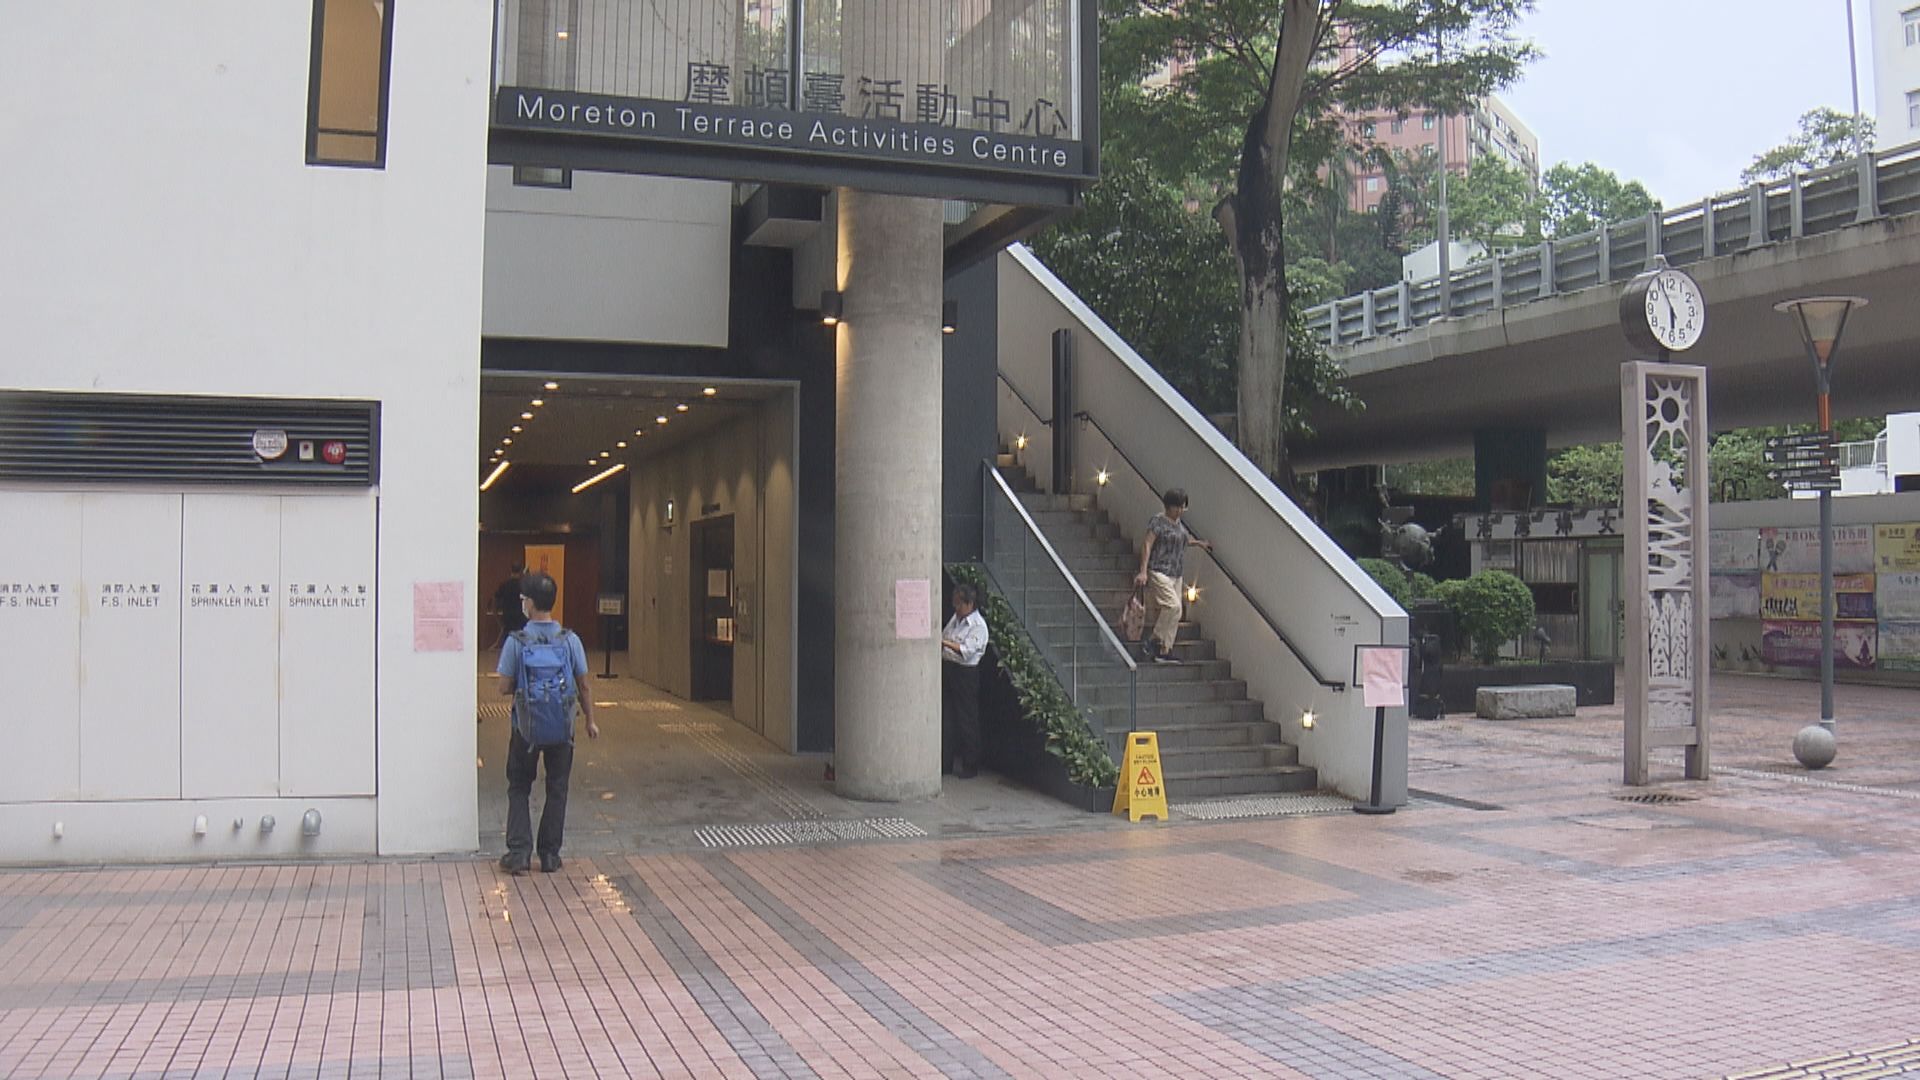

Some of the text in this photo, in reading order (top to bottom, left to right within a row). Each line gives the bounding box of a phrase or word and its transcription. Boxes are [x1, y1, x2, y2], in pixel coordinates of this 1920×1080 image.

[687, 61, 1067, 137] 摩頓臺活動中心
[517, 94, 1067, 167] Moreton Terrace Activities Centre
[1666, 278, 1675, 290] 12
[1649, 290, 1658, 301] 10
[1685, 292, 1691, 303] 2
[1647, 302, 1654, 315] 9
[1688, 306, 1695, 317] 3
[1651, 316, 1658, 327] 8
[1686, 319, 1692, 330] 4
[1660, 327, 1665, 338] 7
[1669, 331, 1675, 343] 6
[1679, 329, 1685, 340] 5
[0, 596, 59, 607] F.S. INLET
[101, 596, 160, 607] F.S. INLET
[191, 597, 269, 607] SPRINKLER INLET
[289, 597, 366, 607] SPRINKLER INLET
